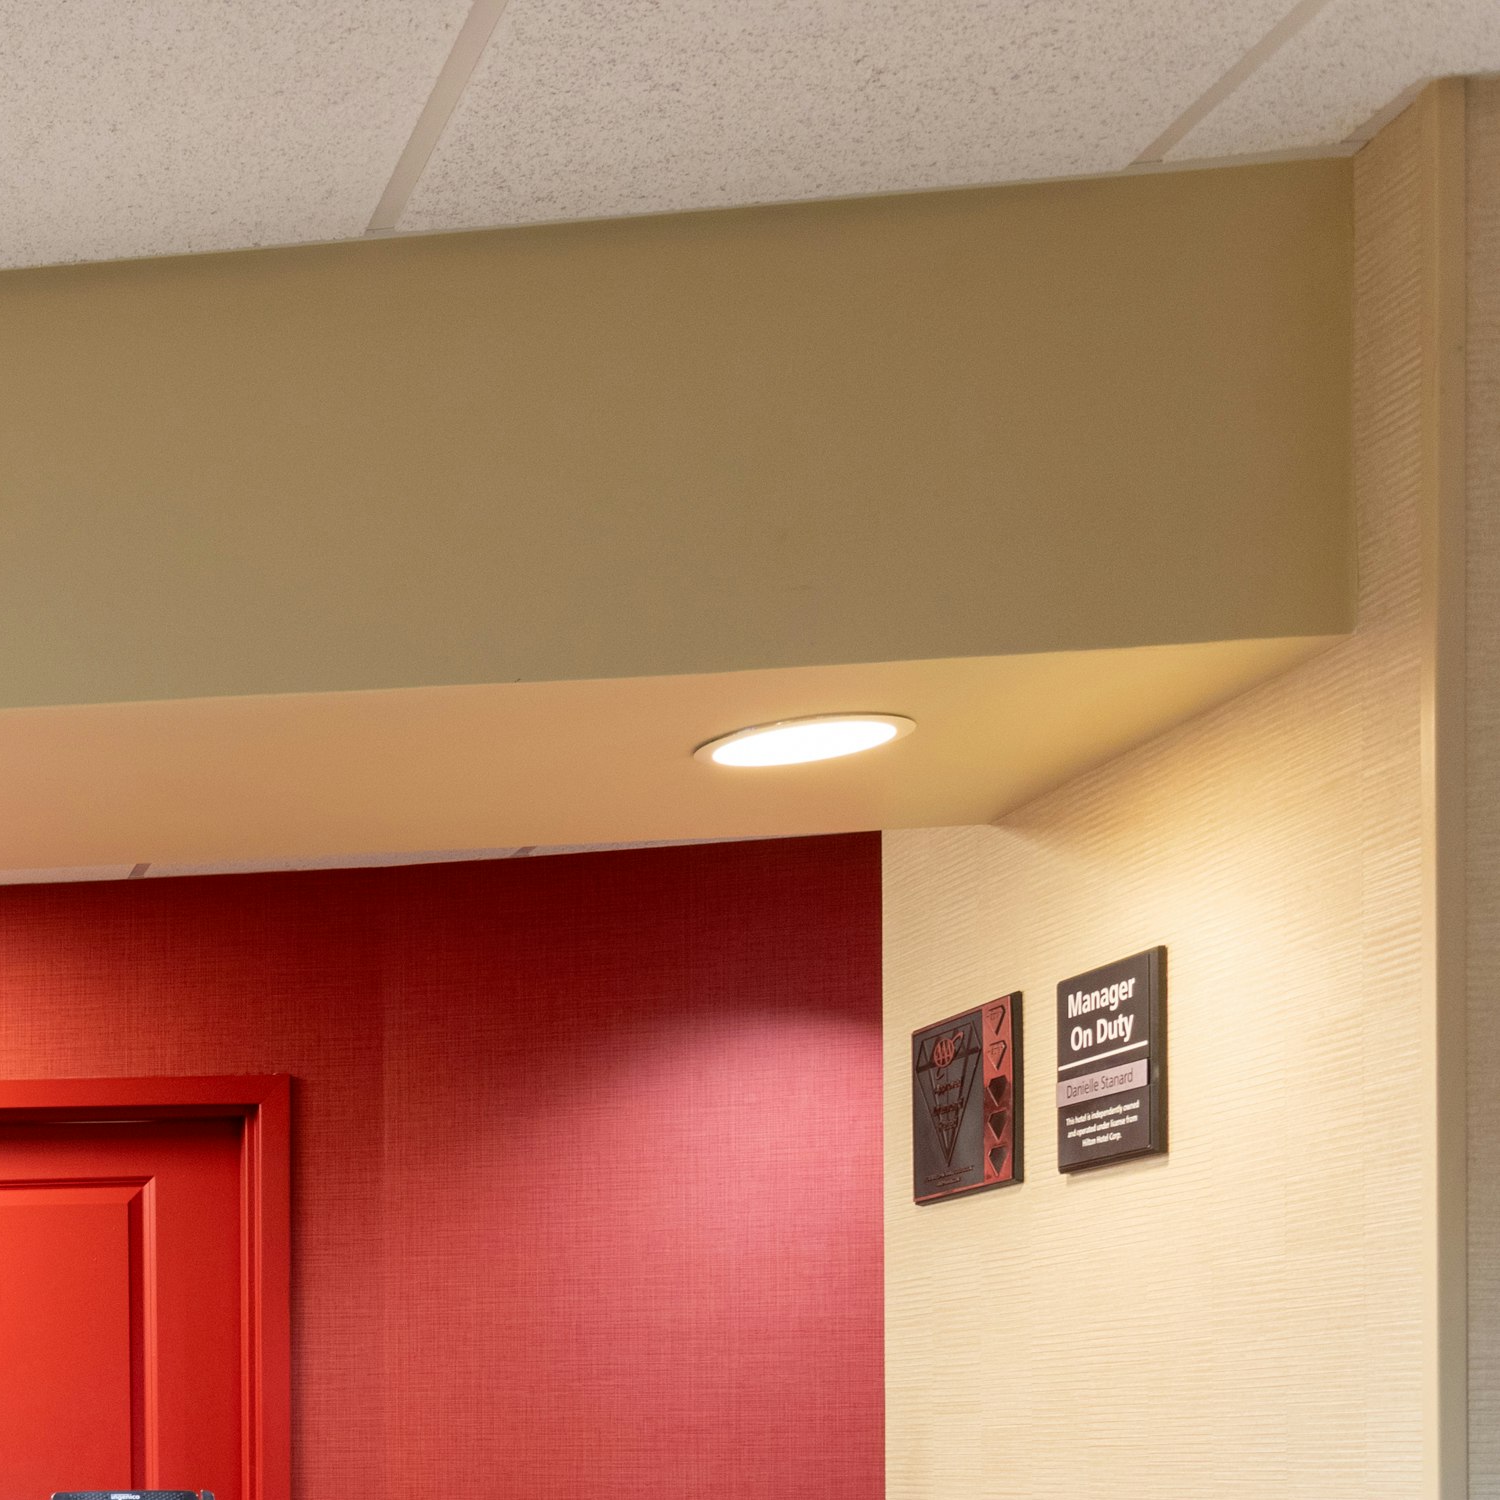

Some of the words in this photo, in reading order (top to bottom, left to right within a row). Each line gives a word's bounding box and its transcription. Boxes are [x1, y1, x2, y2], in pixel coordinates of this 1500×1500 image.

[1068, 977, 1136, 1019] Manager
[1070, 1026, 1093, 1052] On
[1096, 1013, 1134, 1043] Duty
[1066, 1077, 1099, 1099] Danielle
[1101, 1067, 1134, 1090] Stanard
